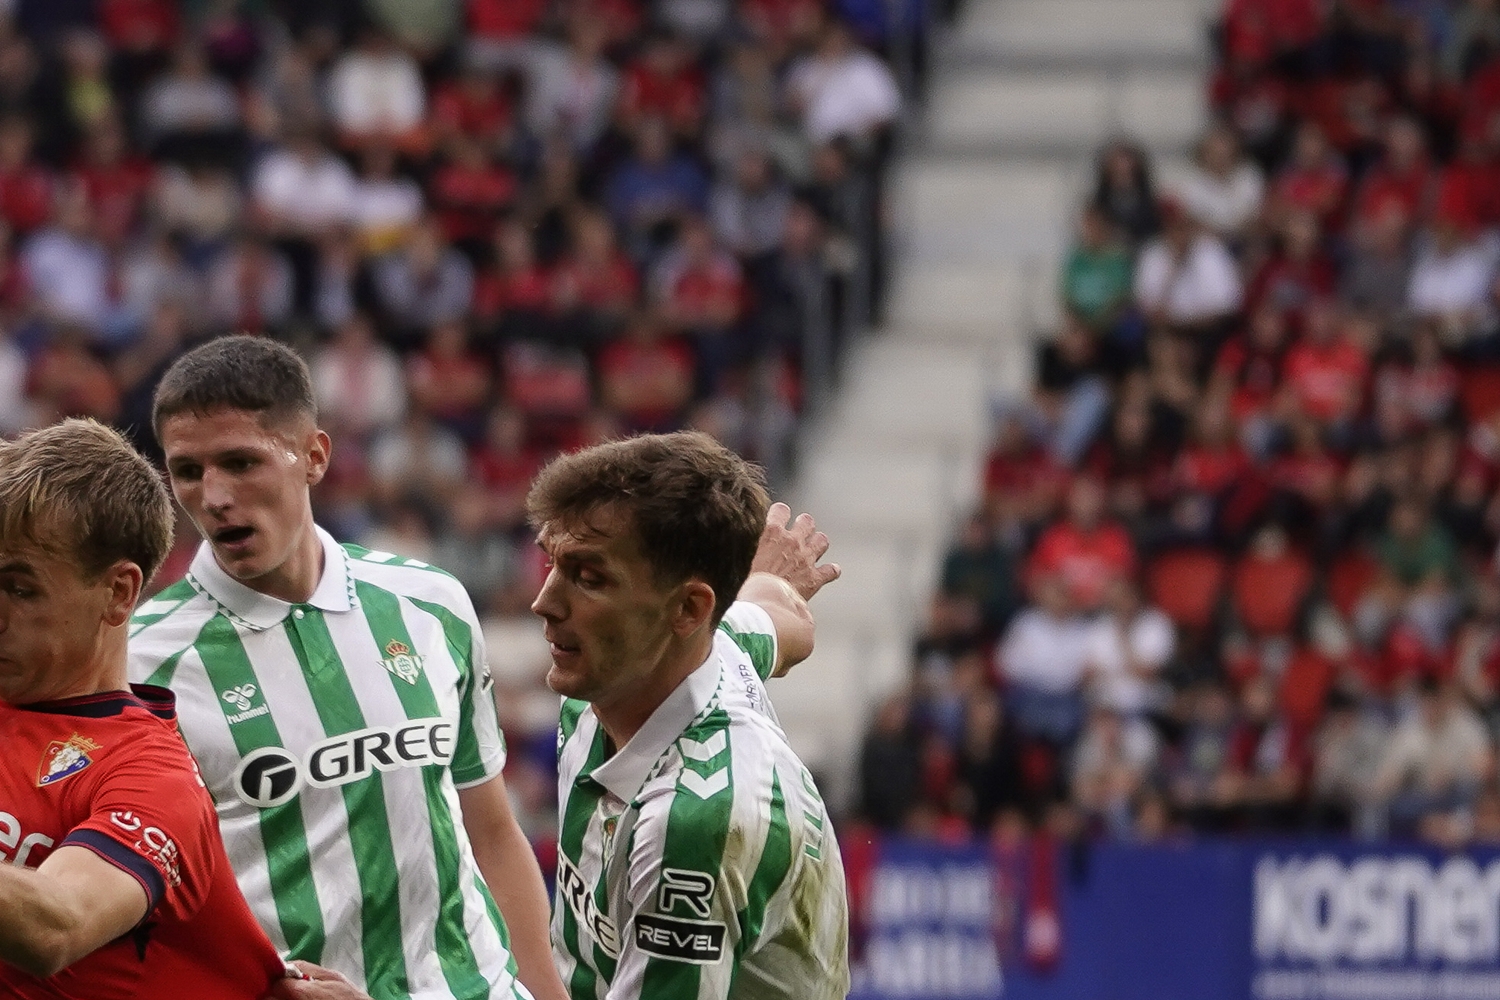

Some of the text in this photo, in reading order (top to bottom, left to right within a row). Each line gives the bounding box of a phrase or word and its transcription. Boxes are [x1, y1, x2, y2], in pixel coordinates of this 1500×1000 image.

[225, 703, 270, 725] hummel
[307, 723, 451, 783] GREE
[638, 923, 720, 951] REVEL
